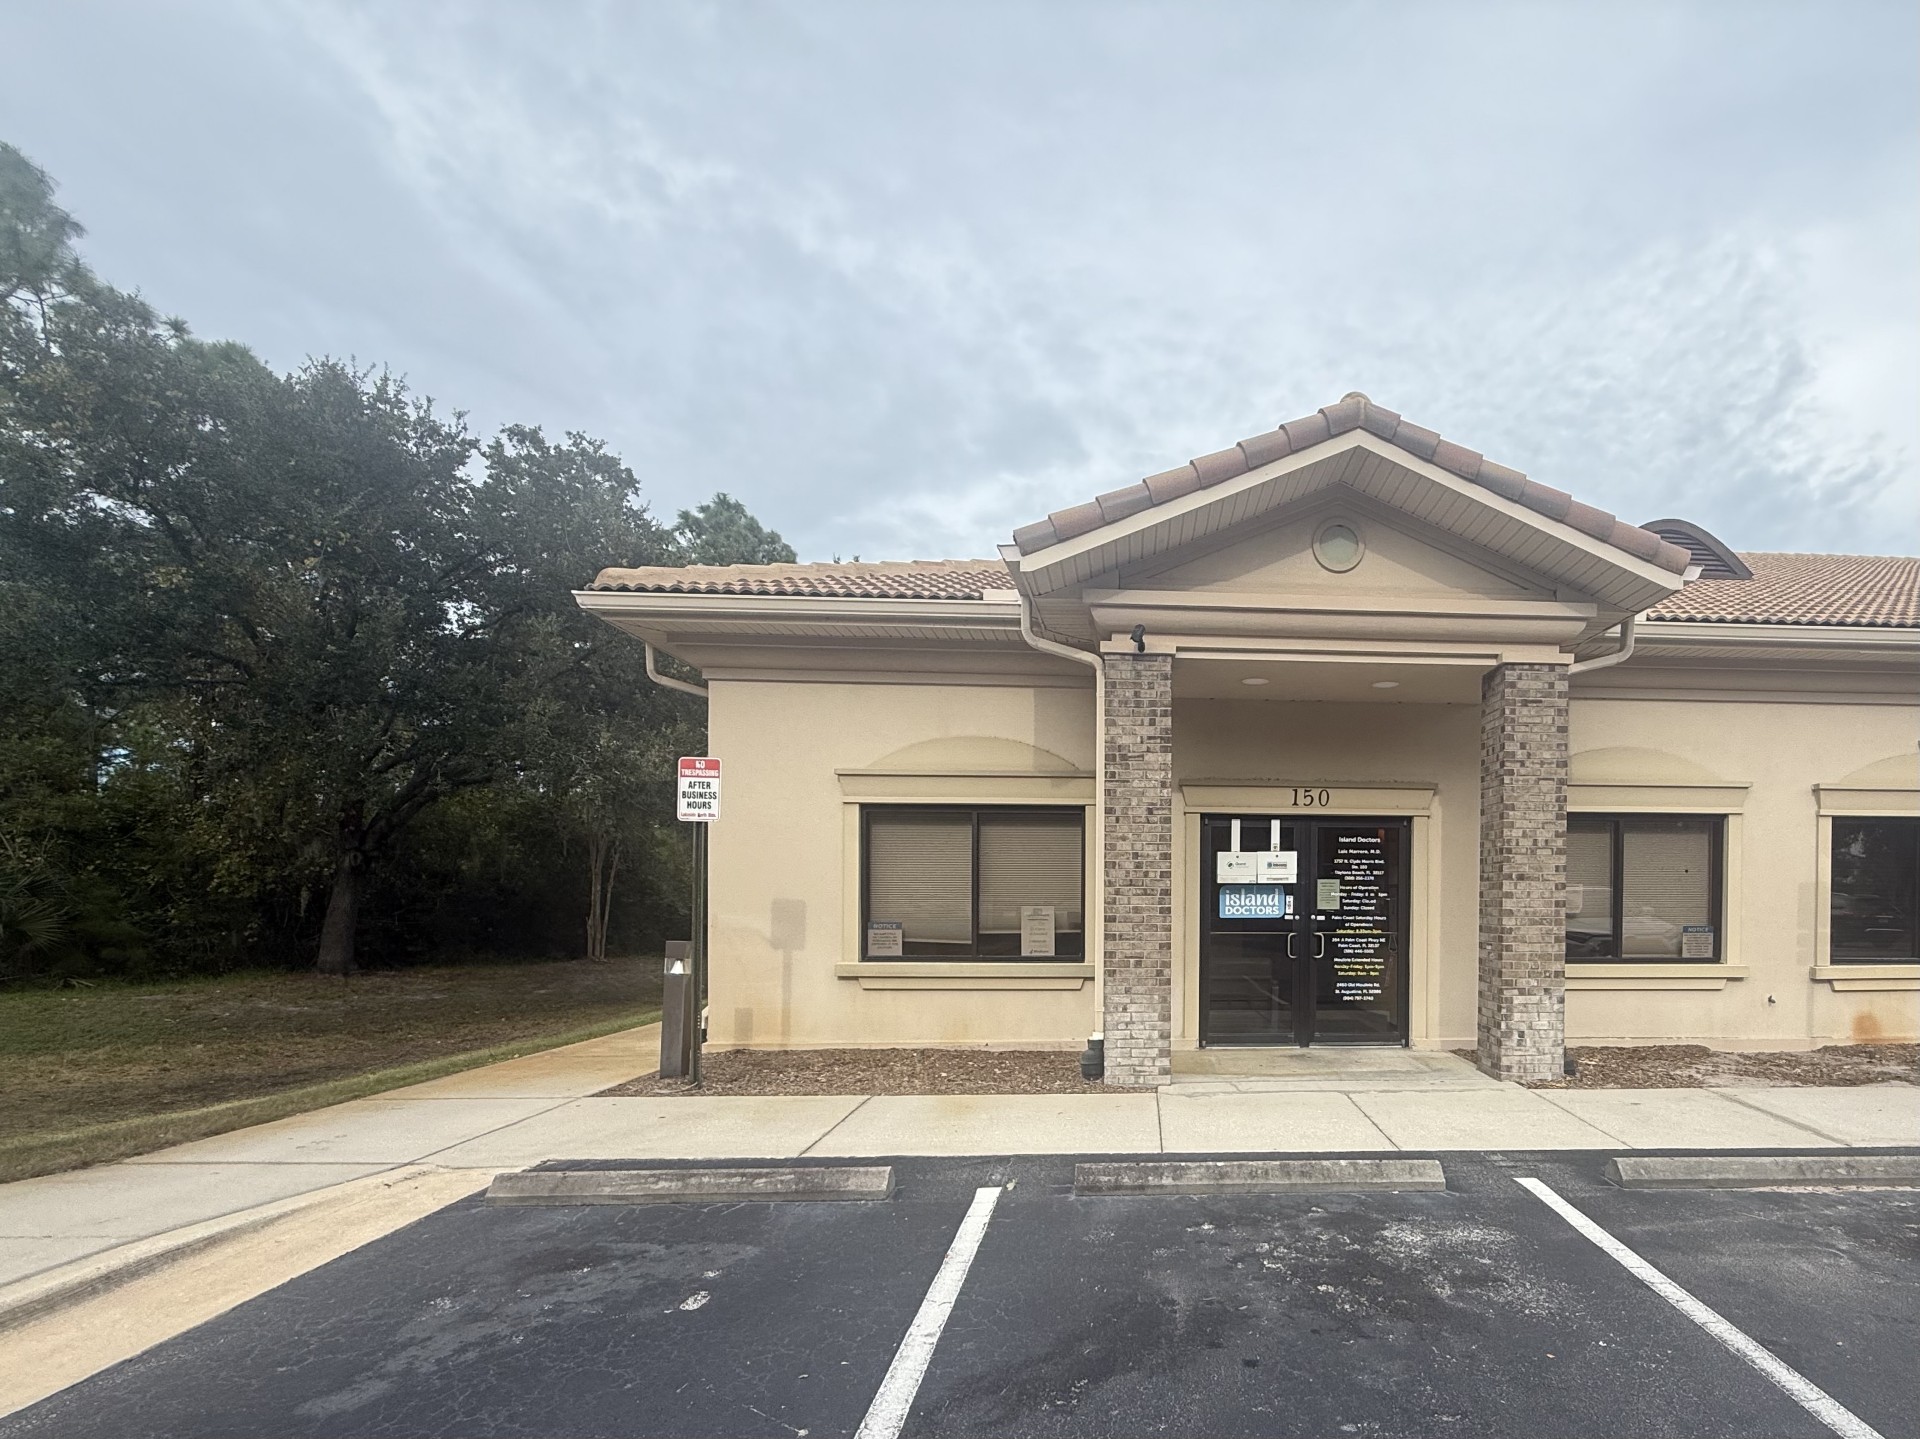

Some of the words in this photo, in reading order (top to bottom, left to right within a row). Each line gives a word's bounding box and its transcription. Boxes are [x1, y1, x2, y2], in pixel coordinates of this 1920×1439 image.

[695, 760, 705, 768] NO
[688, 781, 711, 789] AFTER
[682, 791, 717, 800] BUSINESS
[1292, 789, 1330, 807] 150
[687, 801, 712, 809] HOURS
[1225, 889, 1279, 906] island
[1225, 906, 1279, 915] DOCTORS
